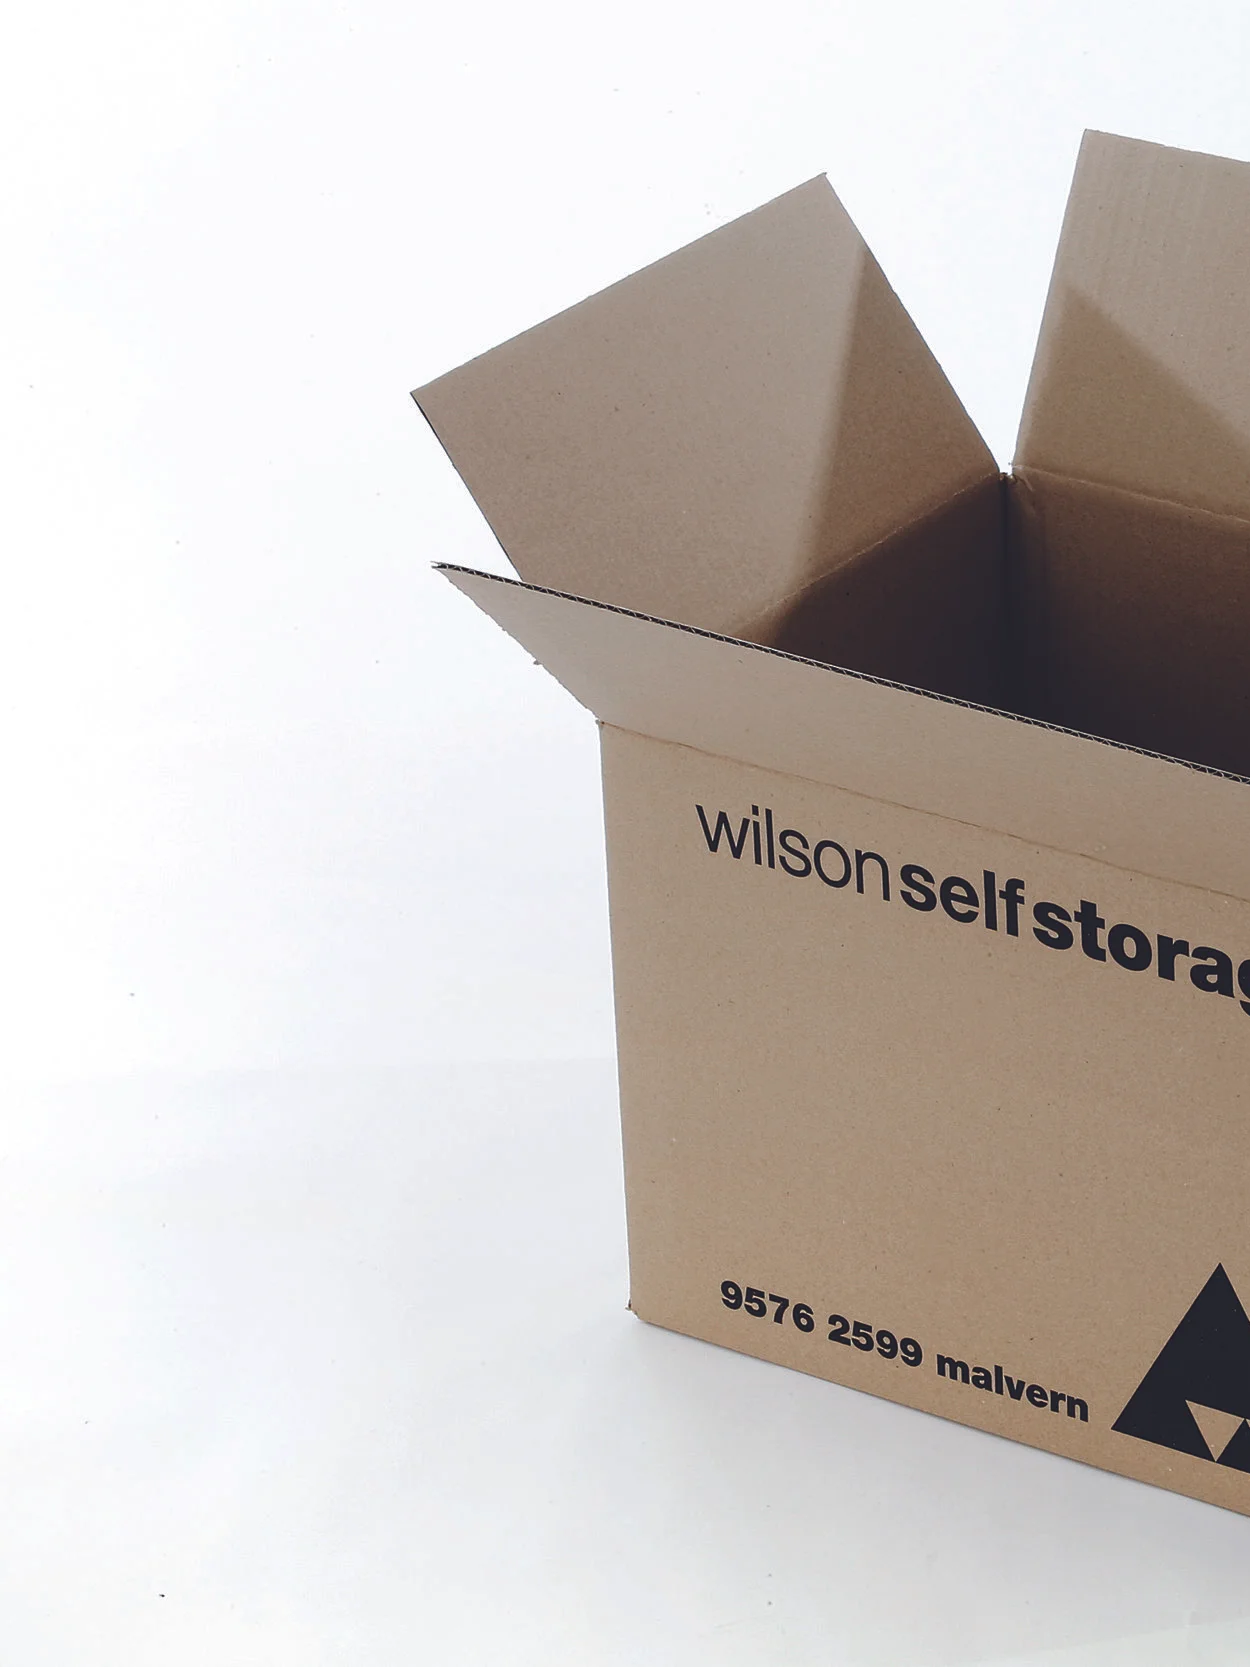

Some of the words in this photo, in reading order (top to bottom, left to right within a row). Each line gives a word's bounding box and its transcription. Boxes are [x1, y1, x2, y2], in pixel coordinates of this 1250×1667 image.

[720, 1280, 815, 1333] 9576
[828, 1314, 923, 1368] 2599
[936, 1353, 1089, 1423] malvern
